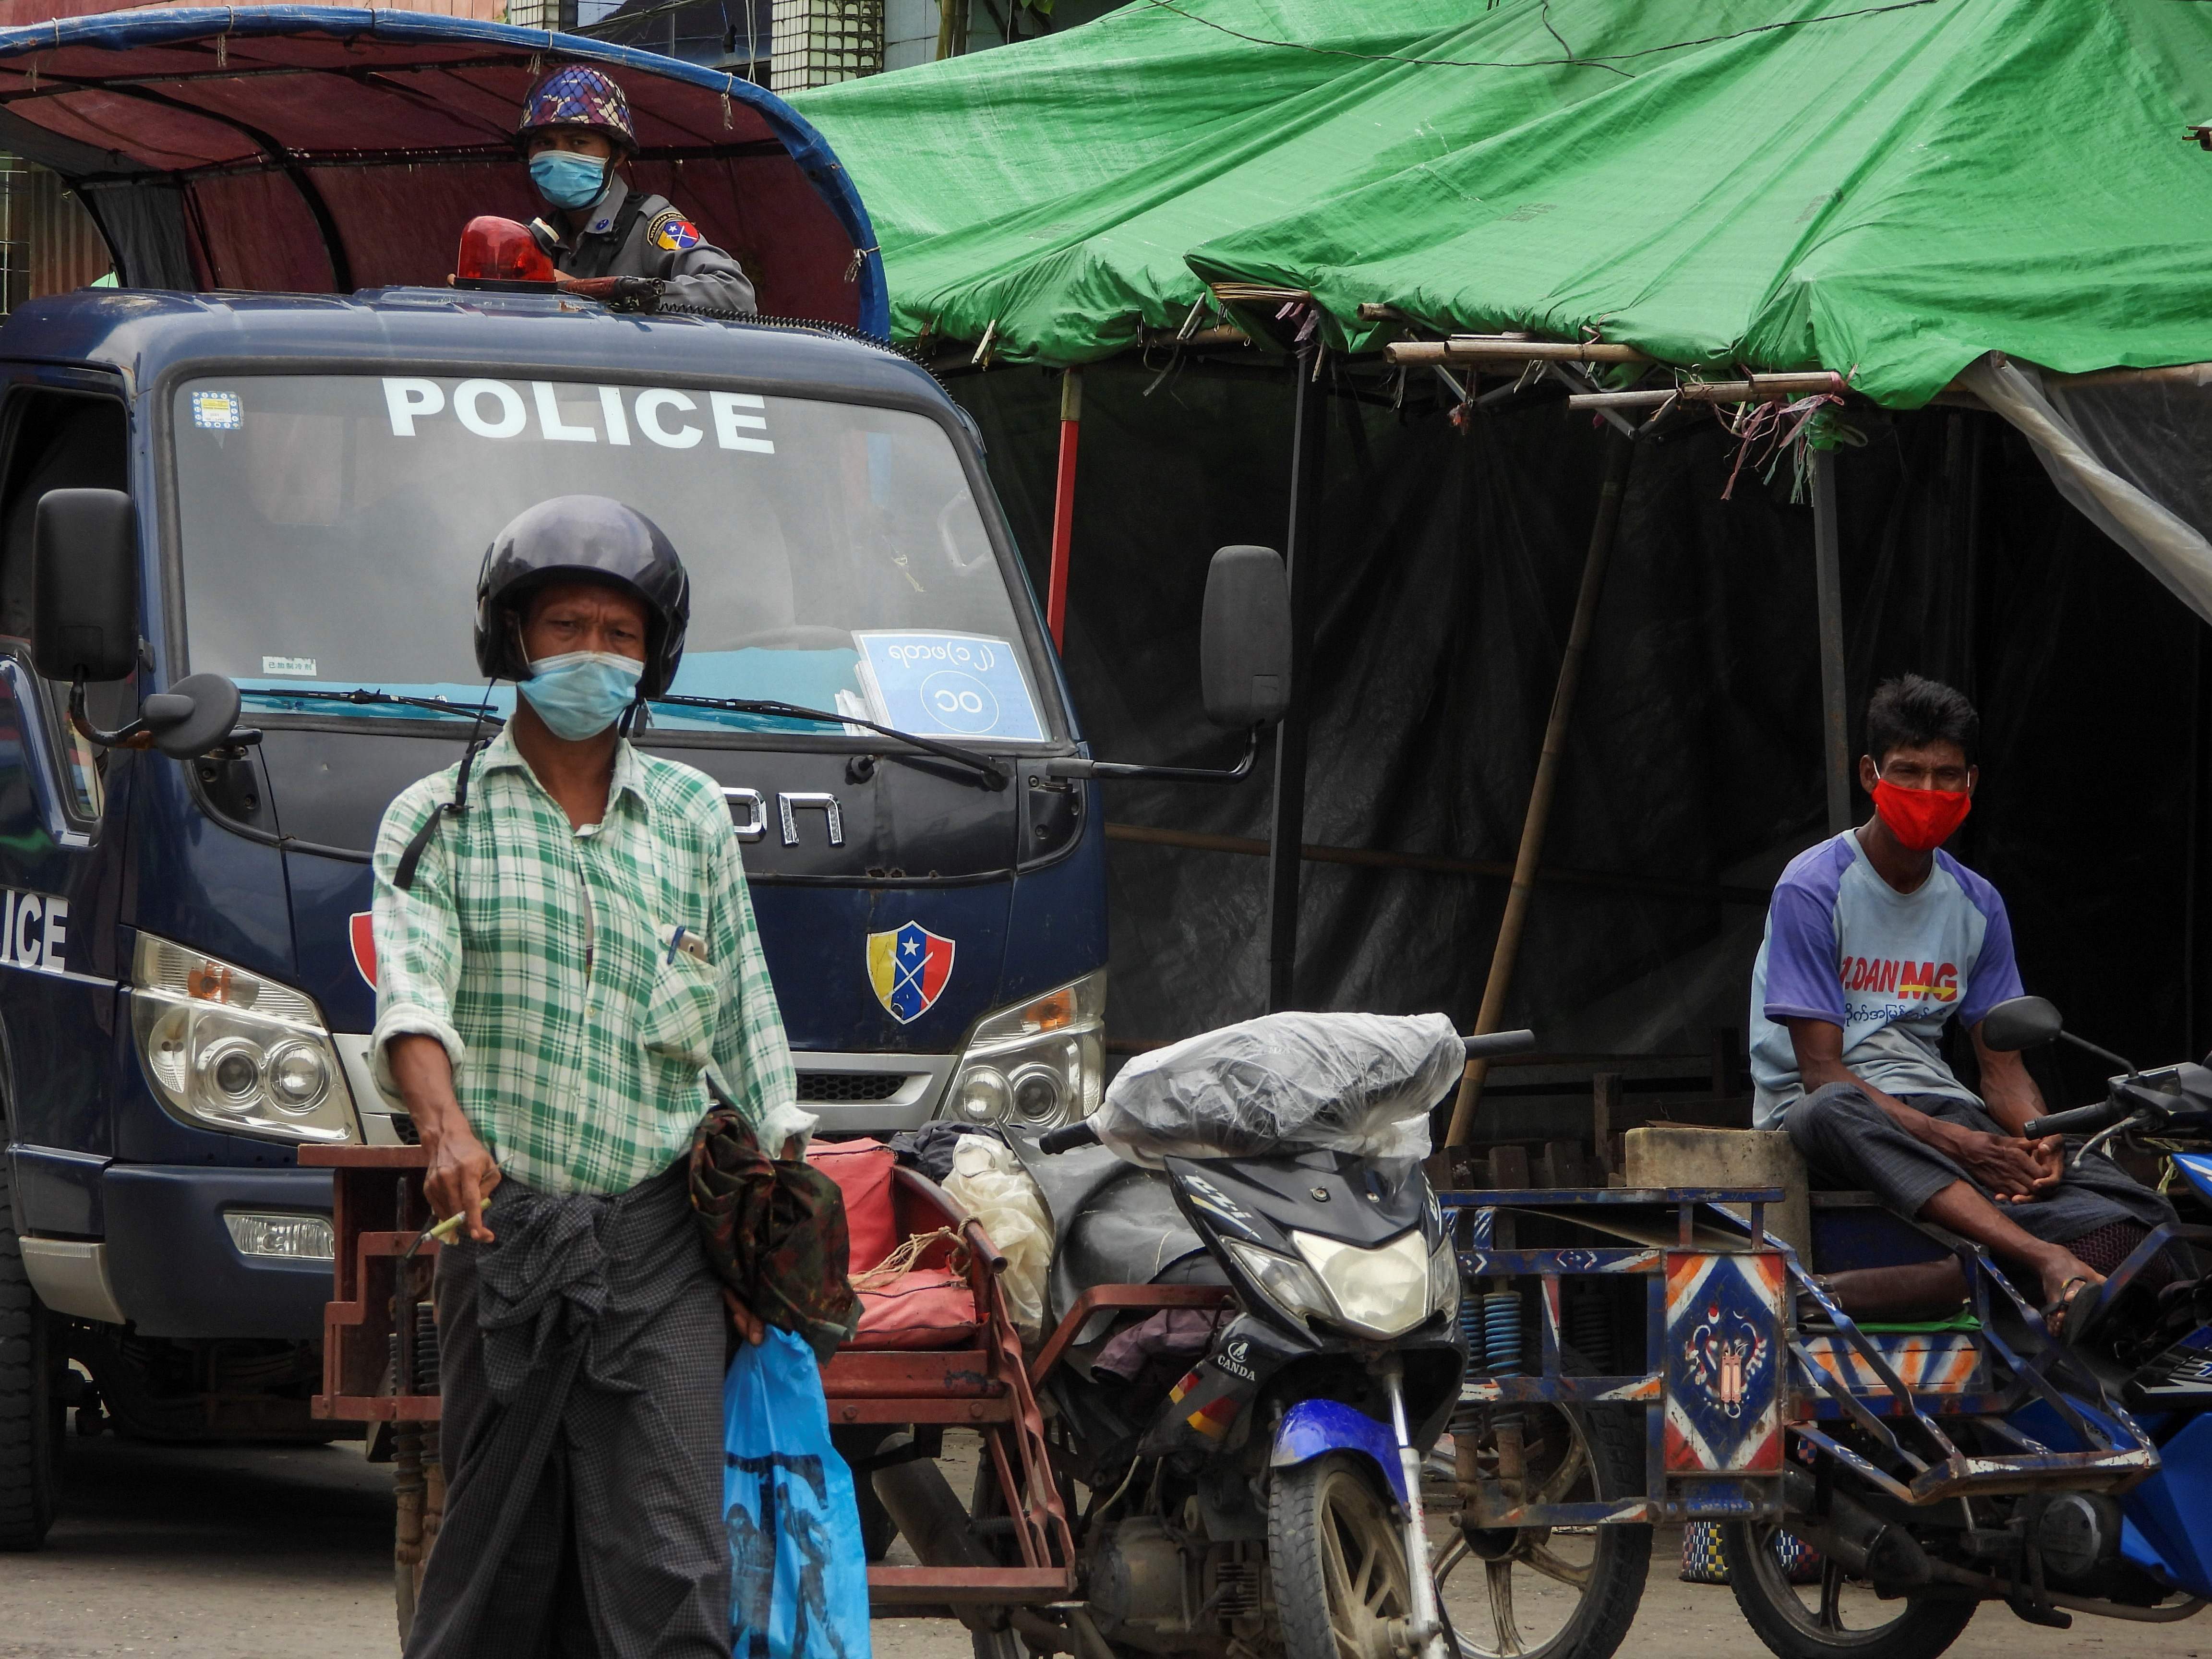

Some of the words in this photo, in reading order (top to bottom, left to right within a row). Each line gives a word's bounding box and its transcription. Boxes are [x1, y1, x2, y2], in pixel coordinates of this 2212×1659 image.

[382, 377, 775, 454] POLICE
[0, 890, 68, 974] ICE
[1898, 961, 1959, 1002] MG
[1218, 1355, 1255, 1382] CANDA
